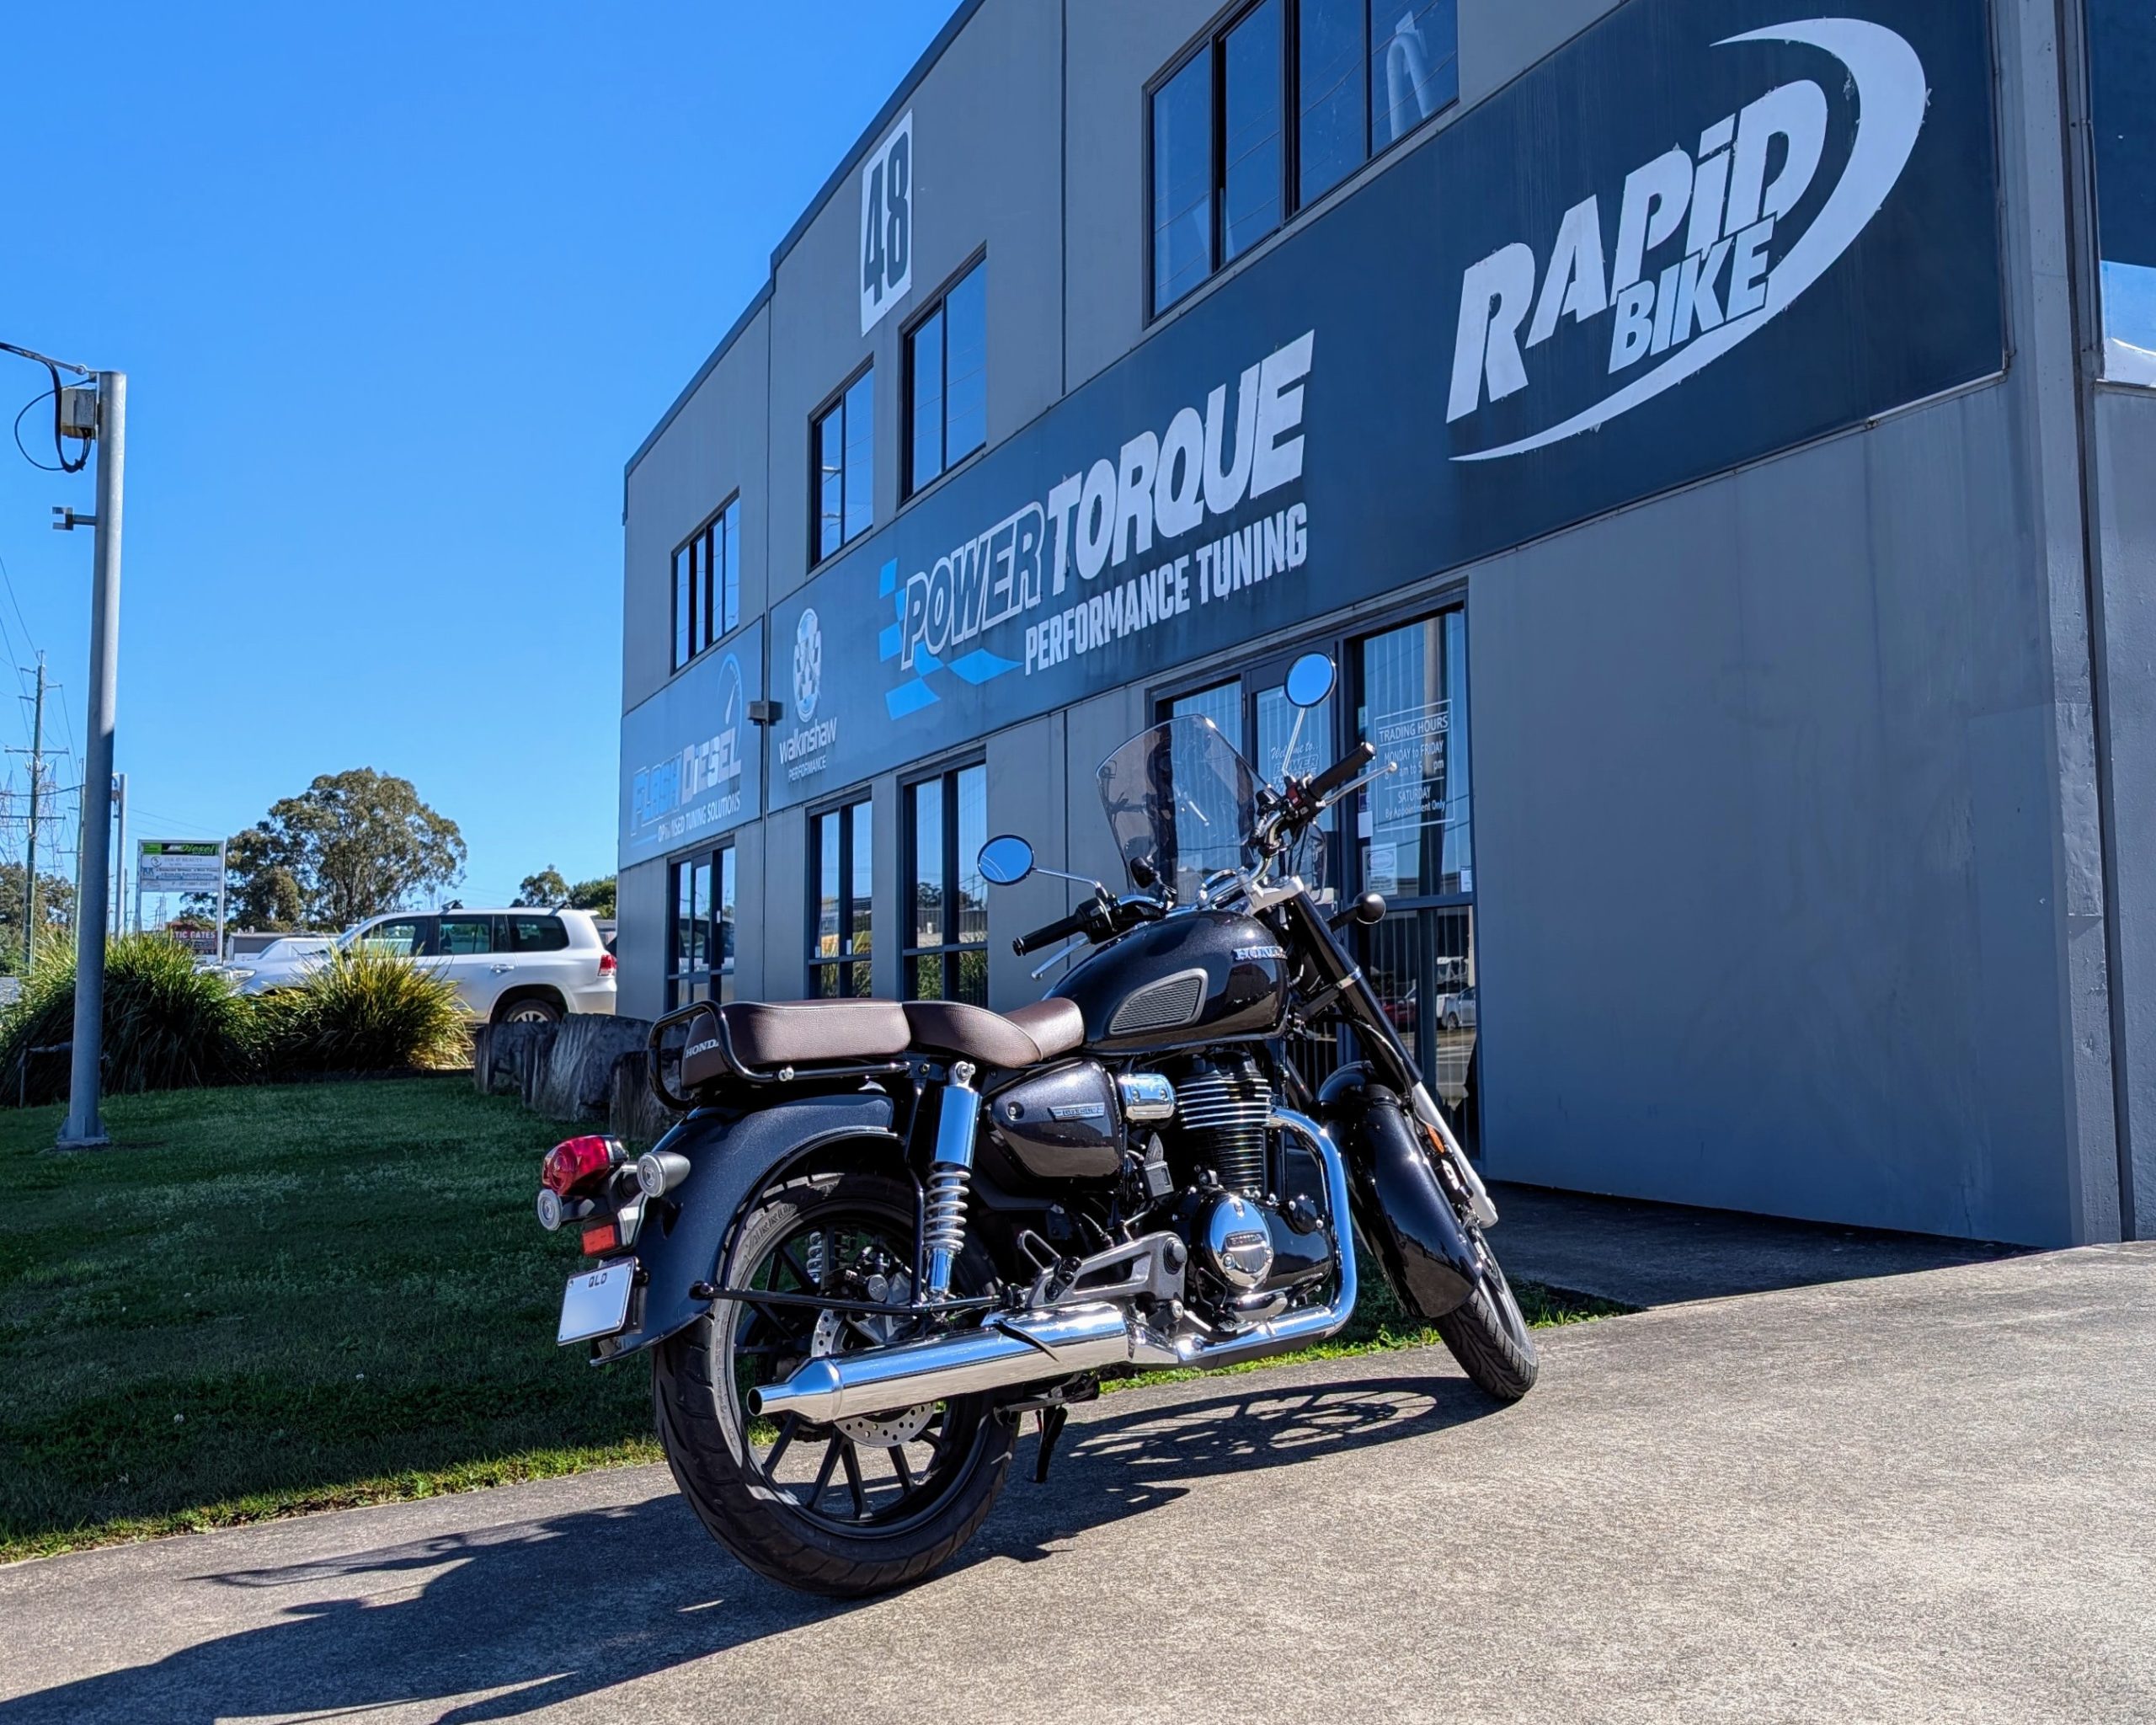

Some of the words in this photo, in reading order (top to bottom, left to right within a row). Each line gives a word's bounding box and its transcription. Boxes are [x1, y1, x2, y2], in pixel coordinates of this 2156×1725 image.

[864, 131, 909, 307] 48
[1608, 216, 1775, 374] BIKE
[900, 500, 1045, 671] POWER
[1047, 328, 1315, 596] TORQUE
[1025, 553, 1191, 676] PERFORMANCE
[1195, 502, 1308, 605] TUNING
[779, 717, 837, 765] walkinshaw
[1379, 723, 1416, 742] TRADING
[1417, 715, 1449, 734] HOURS
[1273, 754, 1319, 776] PWER
[1384, 747, 1411, 764] MONDAY
[1412, 748, 1419, 758] to
[1420, 740, 1444, 757] FRIDAY
[788, 755, 826, 782] PERFORMANCE
[1400, 766, 1409, 777] am
[1410, 763, 1417, 773] to
[1433, 758, 1444, 773] pm
[1398, 786, 1431, 804] SATURDAY
[686, 804, 707, 830] TUNING
[707, 790, 741, 824] SOLUTIONS
[1385, 807, 1393, 820] By
[1394, 803, 1431, 817] Appointment
[1432, 798, 1446, 812] Only
[588, 1272, 608, 1288] QLD
